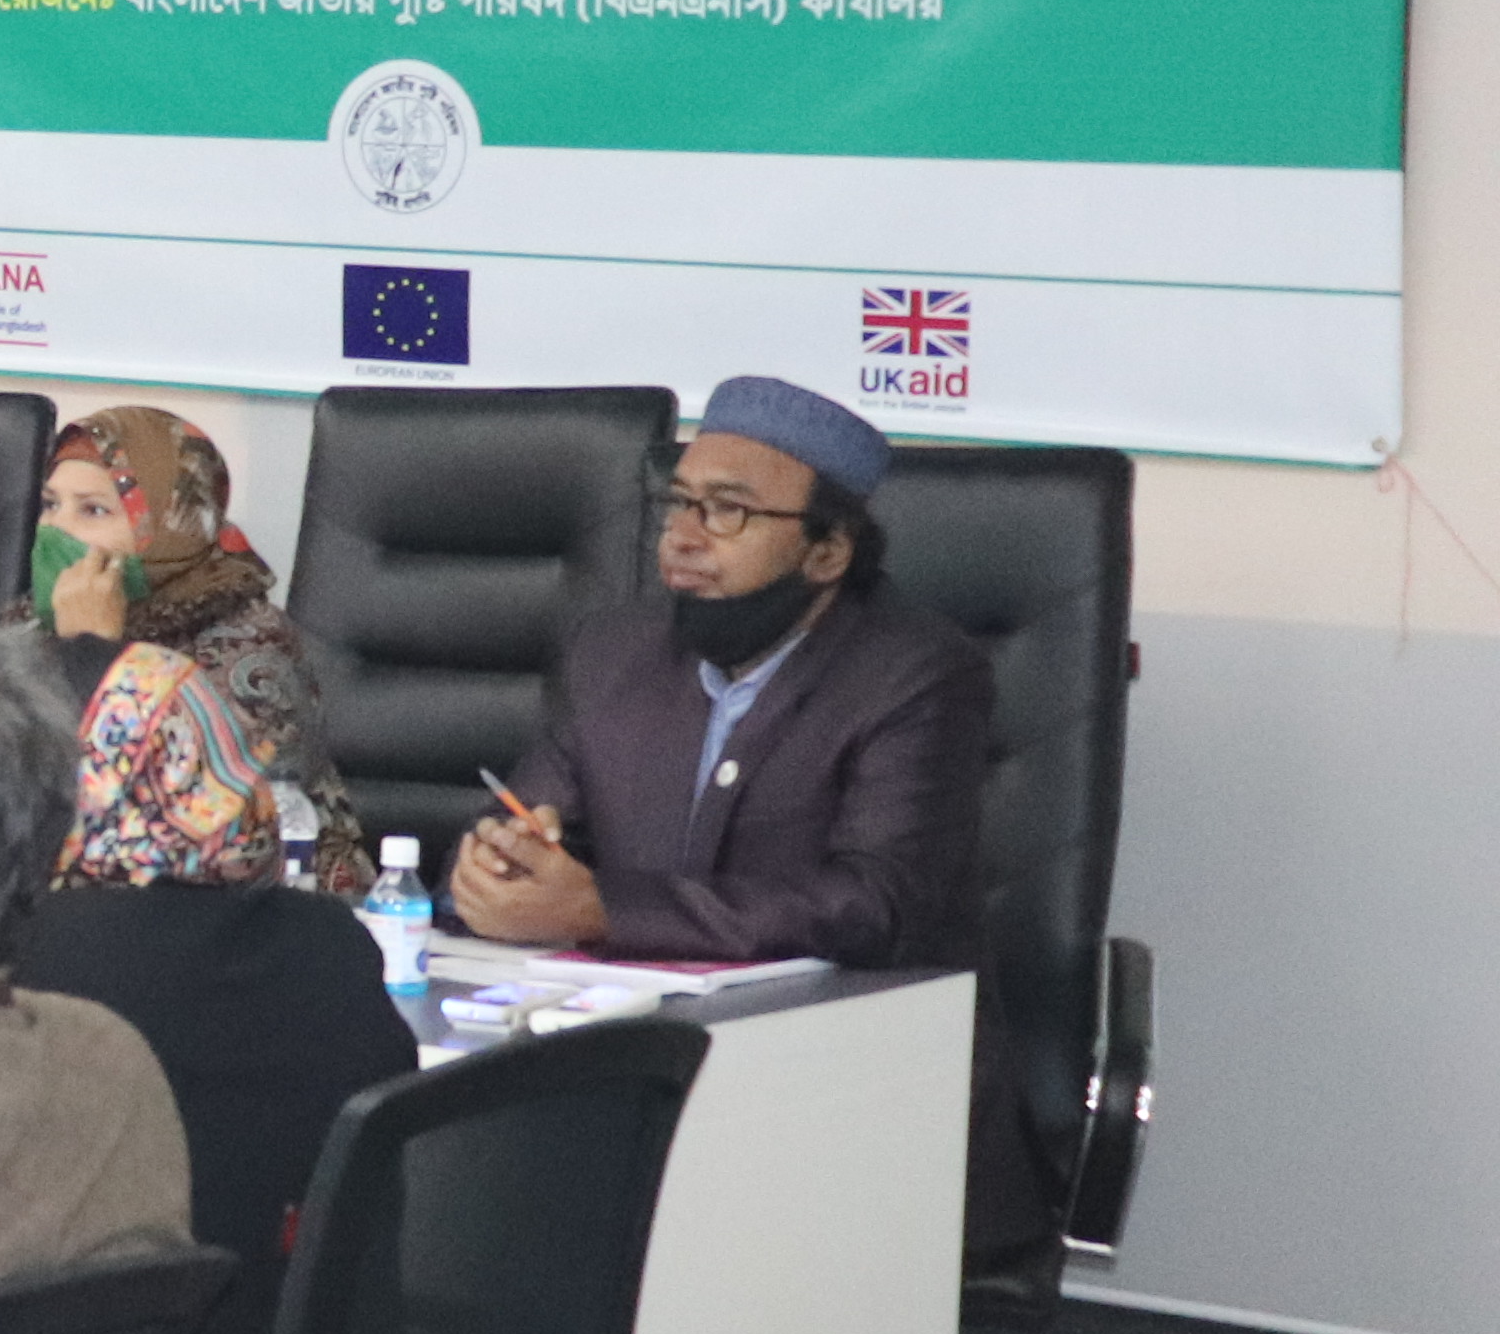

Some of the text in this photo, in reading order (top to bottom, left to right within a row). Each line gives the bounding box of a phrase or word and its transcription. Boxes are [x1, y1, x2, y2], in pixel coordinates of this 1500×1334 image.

[10, 302, 20, 315] of
[356, 365, 455, 380] EUROPEAN UNION
